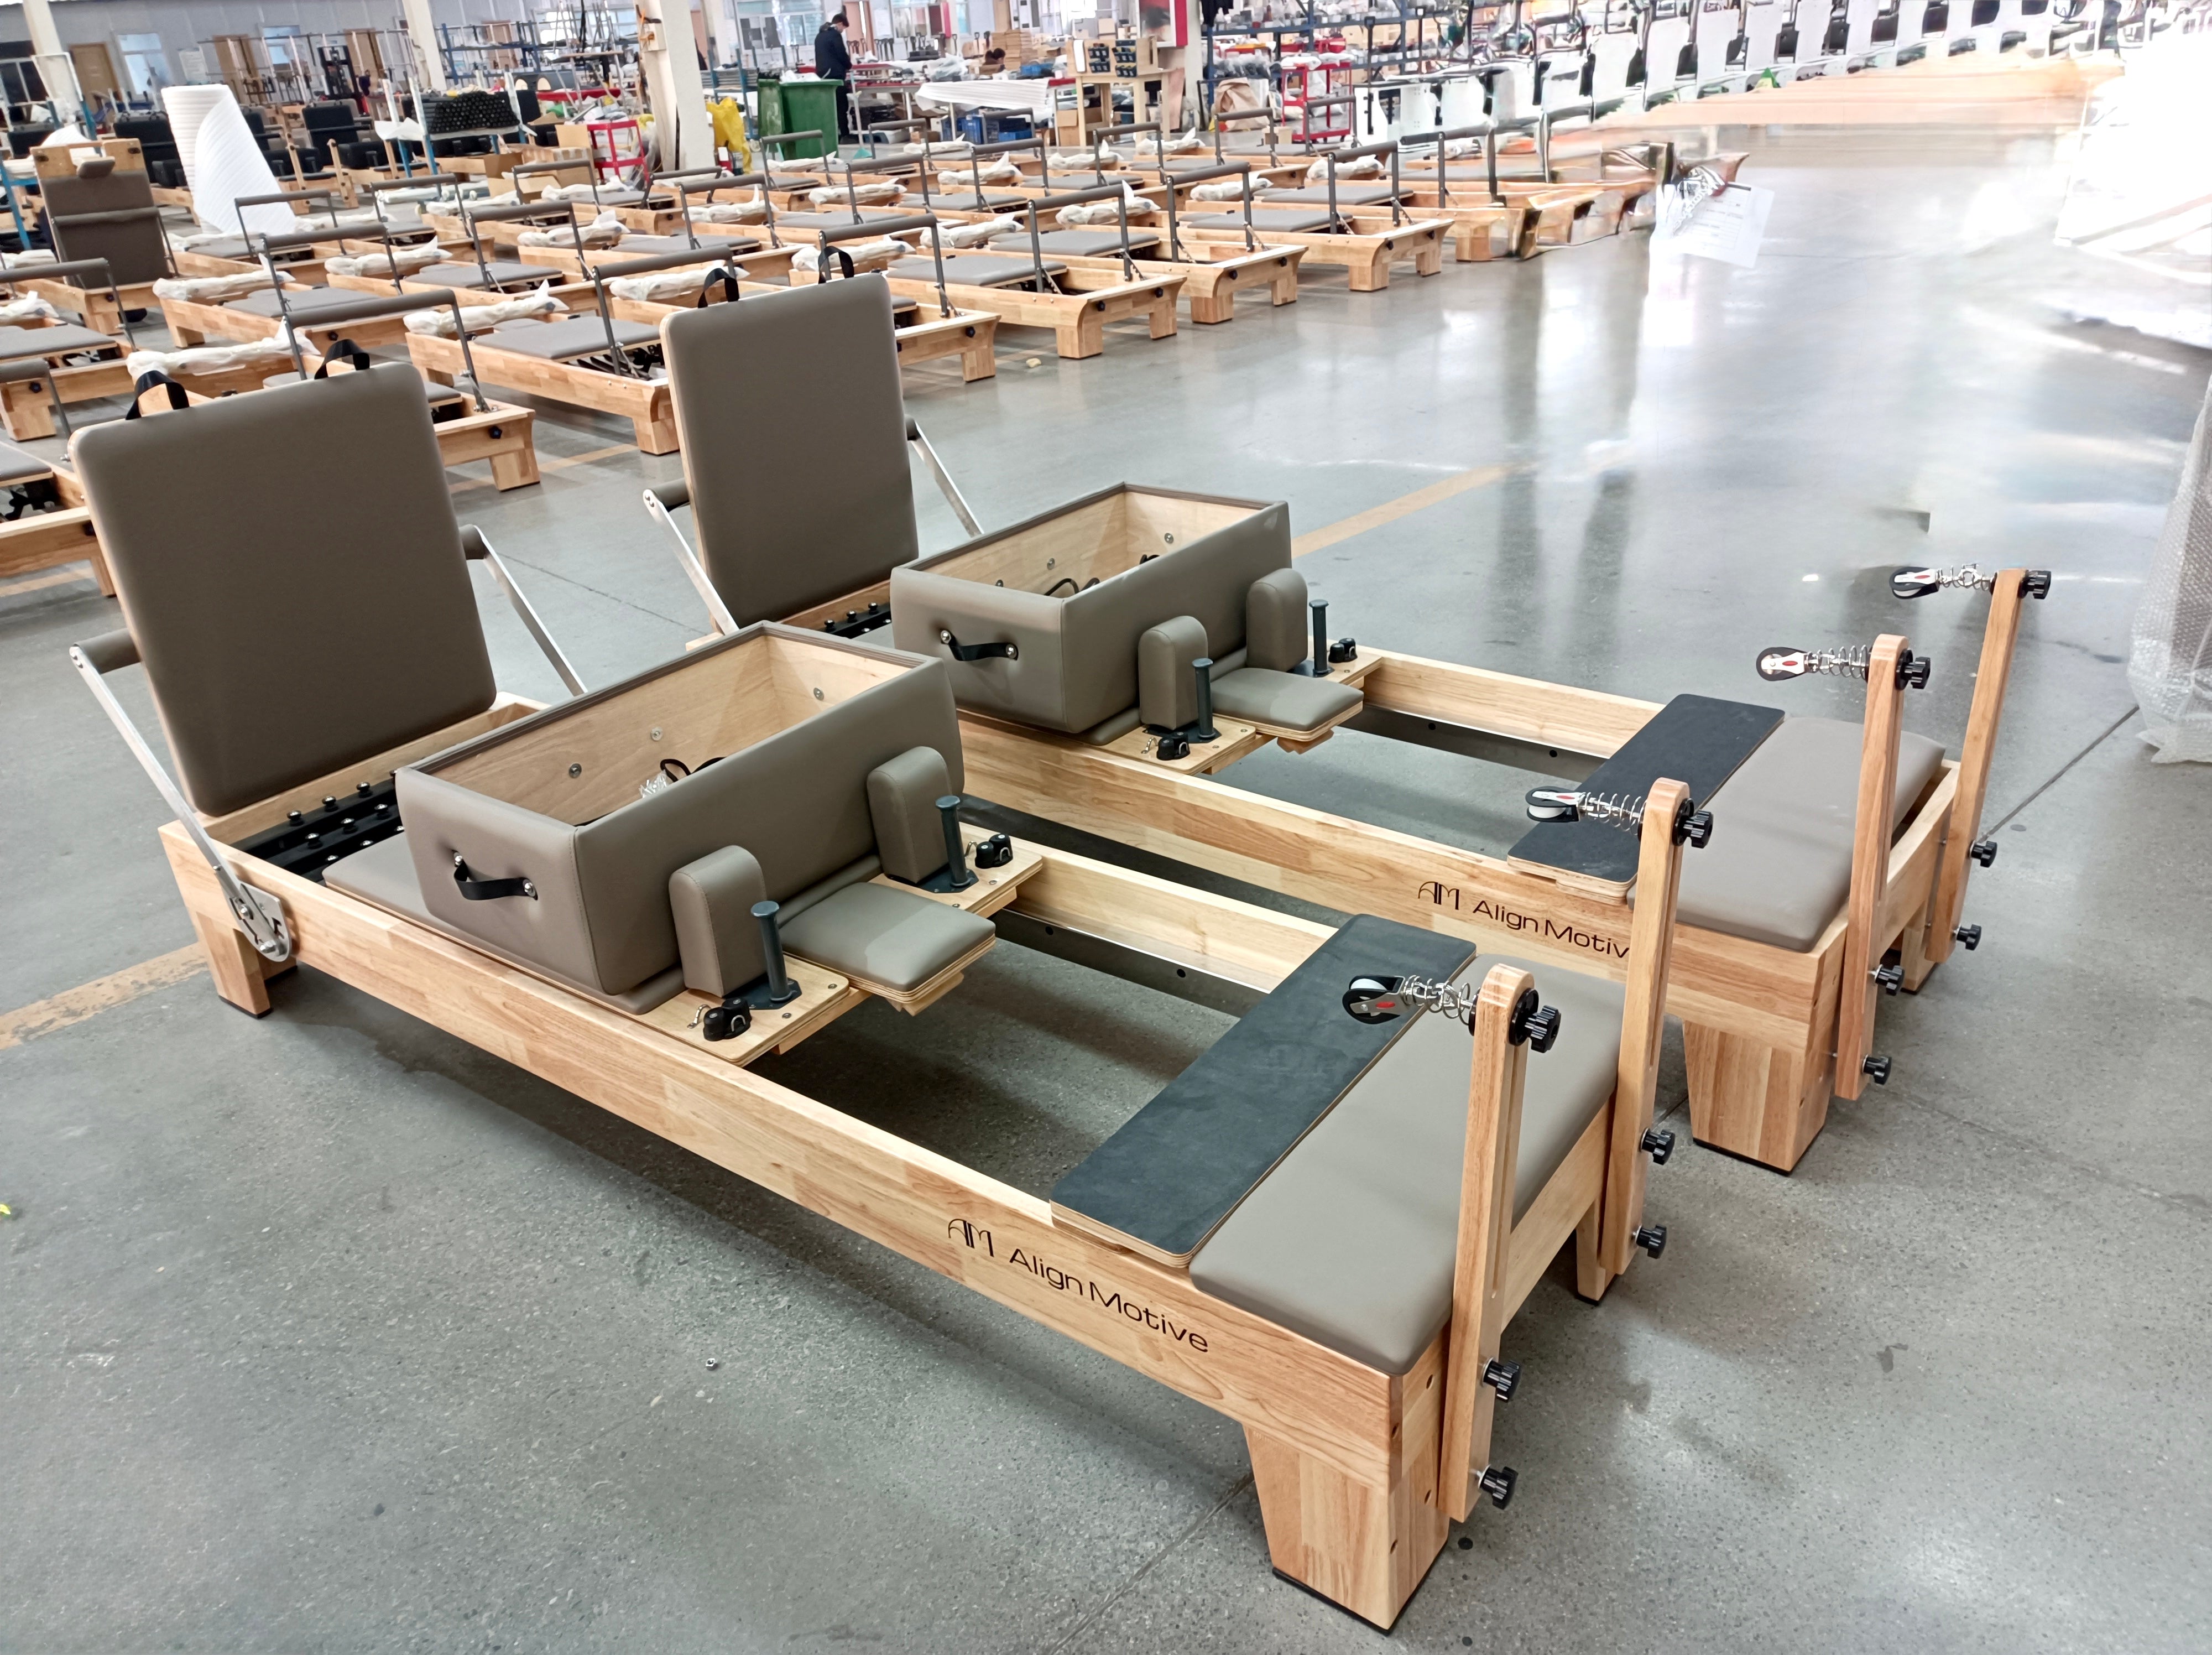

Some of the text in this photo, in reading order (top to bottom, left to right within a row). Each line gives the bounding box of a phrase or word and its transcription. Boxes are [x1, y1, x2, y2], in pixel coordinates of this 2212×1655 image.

[1472, 900, 1539, 933] Align
[1545, 919, 1630, 959] Motiv
[1009, 1248, 1084, 1295] Align
[1089, 1281, 1209, 1353] Motive
